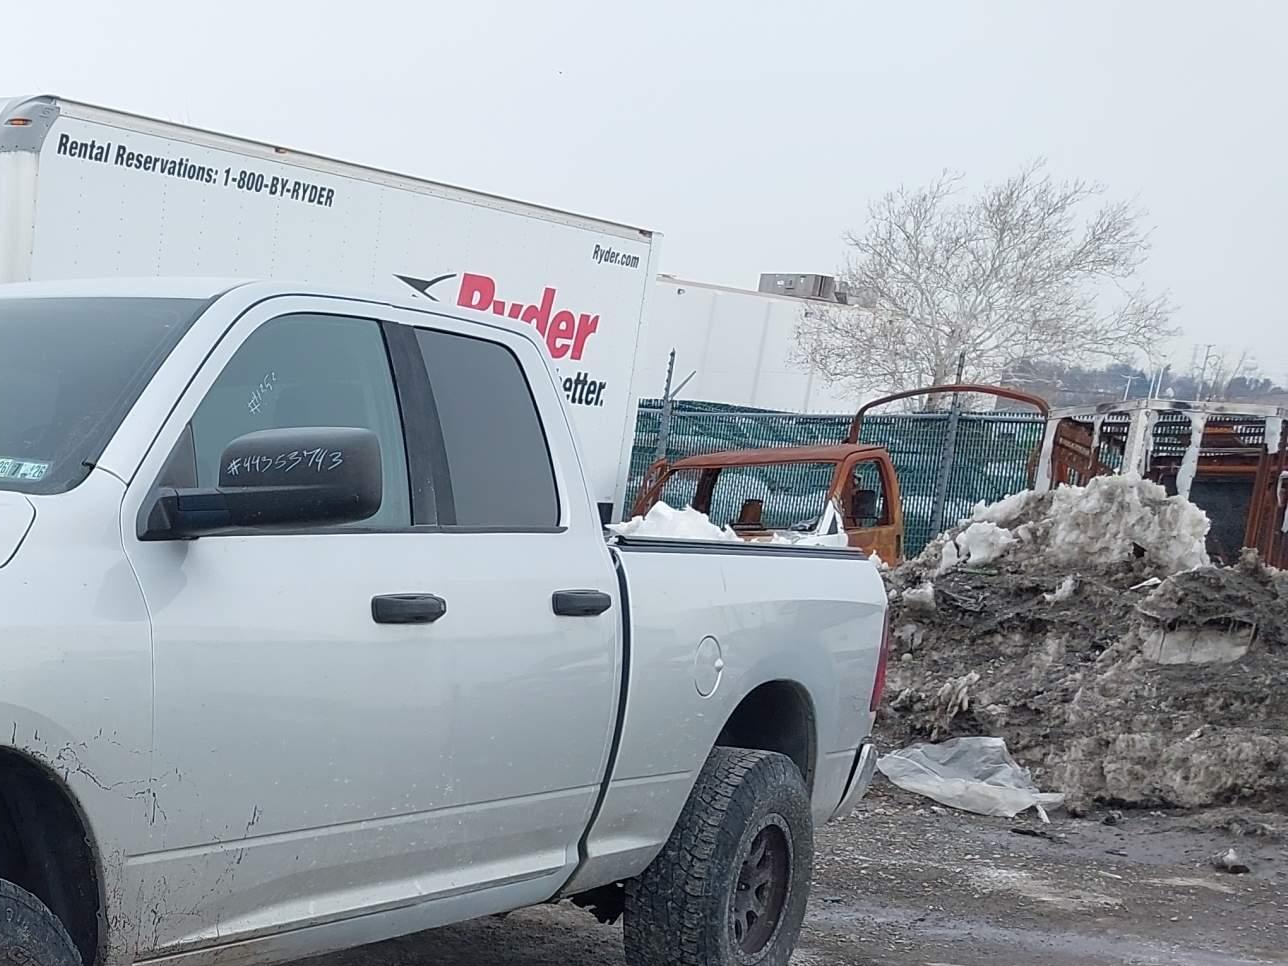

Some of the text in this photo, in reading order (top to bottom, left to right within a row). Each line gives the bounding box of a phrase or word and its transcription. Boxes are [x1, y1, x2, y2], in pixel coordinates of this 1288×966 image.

[57, 133, 336, 207] Rental Reservations: 1-800-BY-RYDER
[592, 244, 640, 269] Ryder.com
[557, 368, 607, 407] etter.
